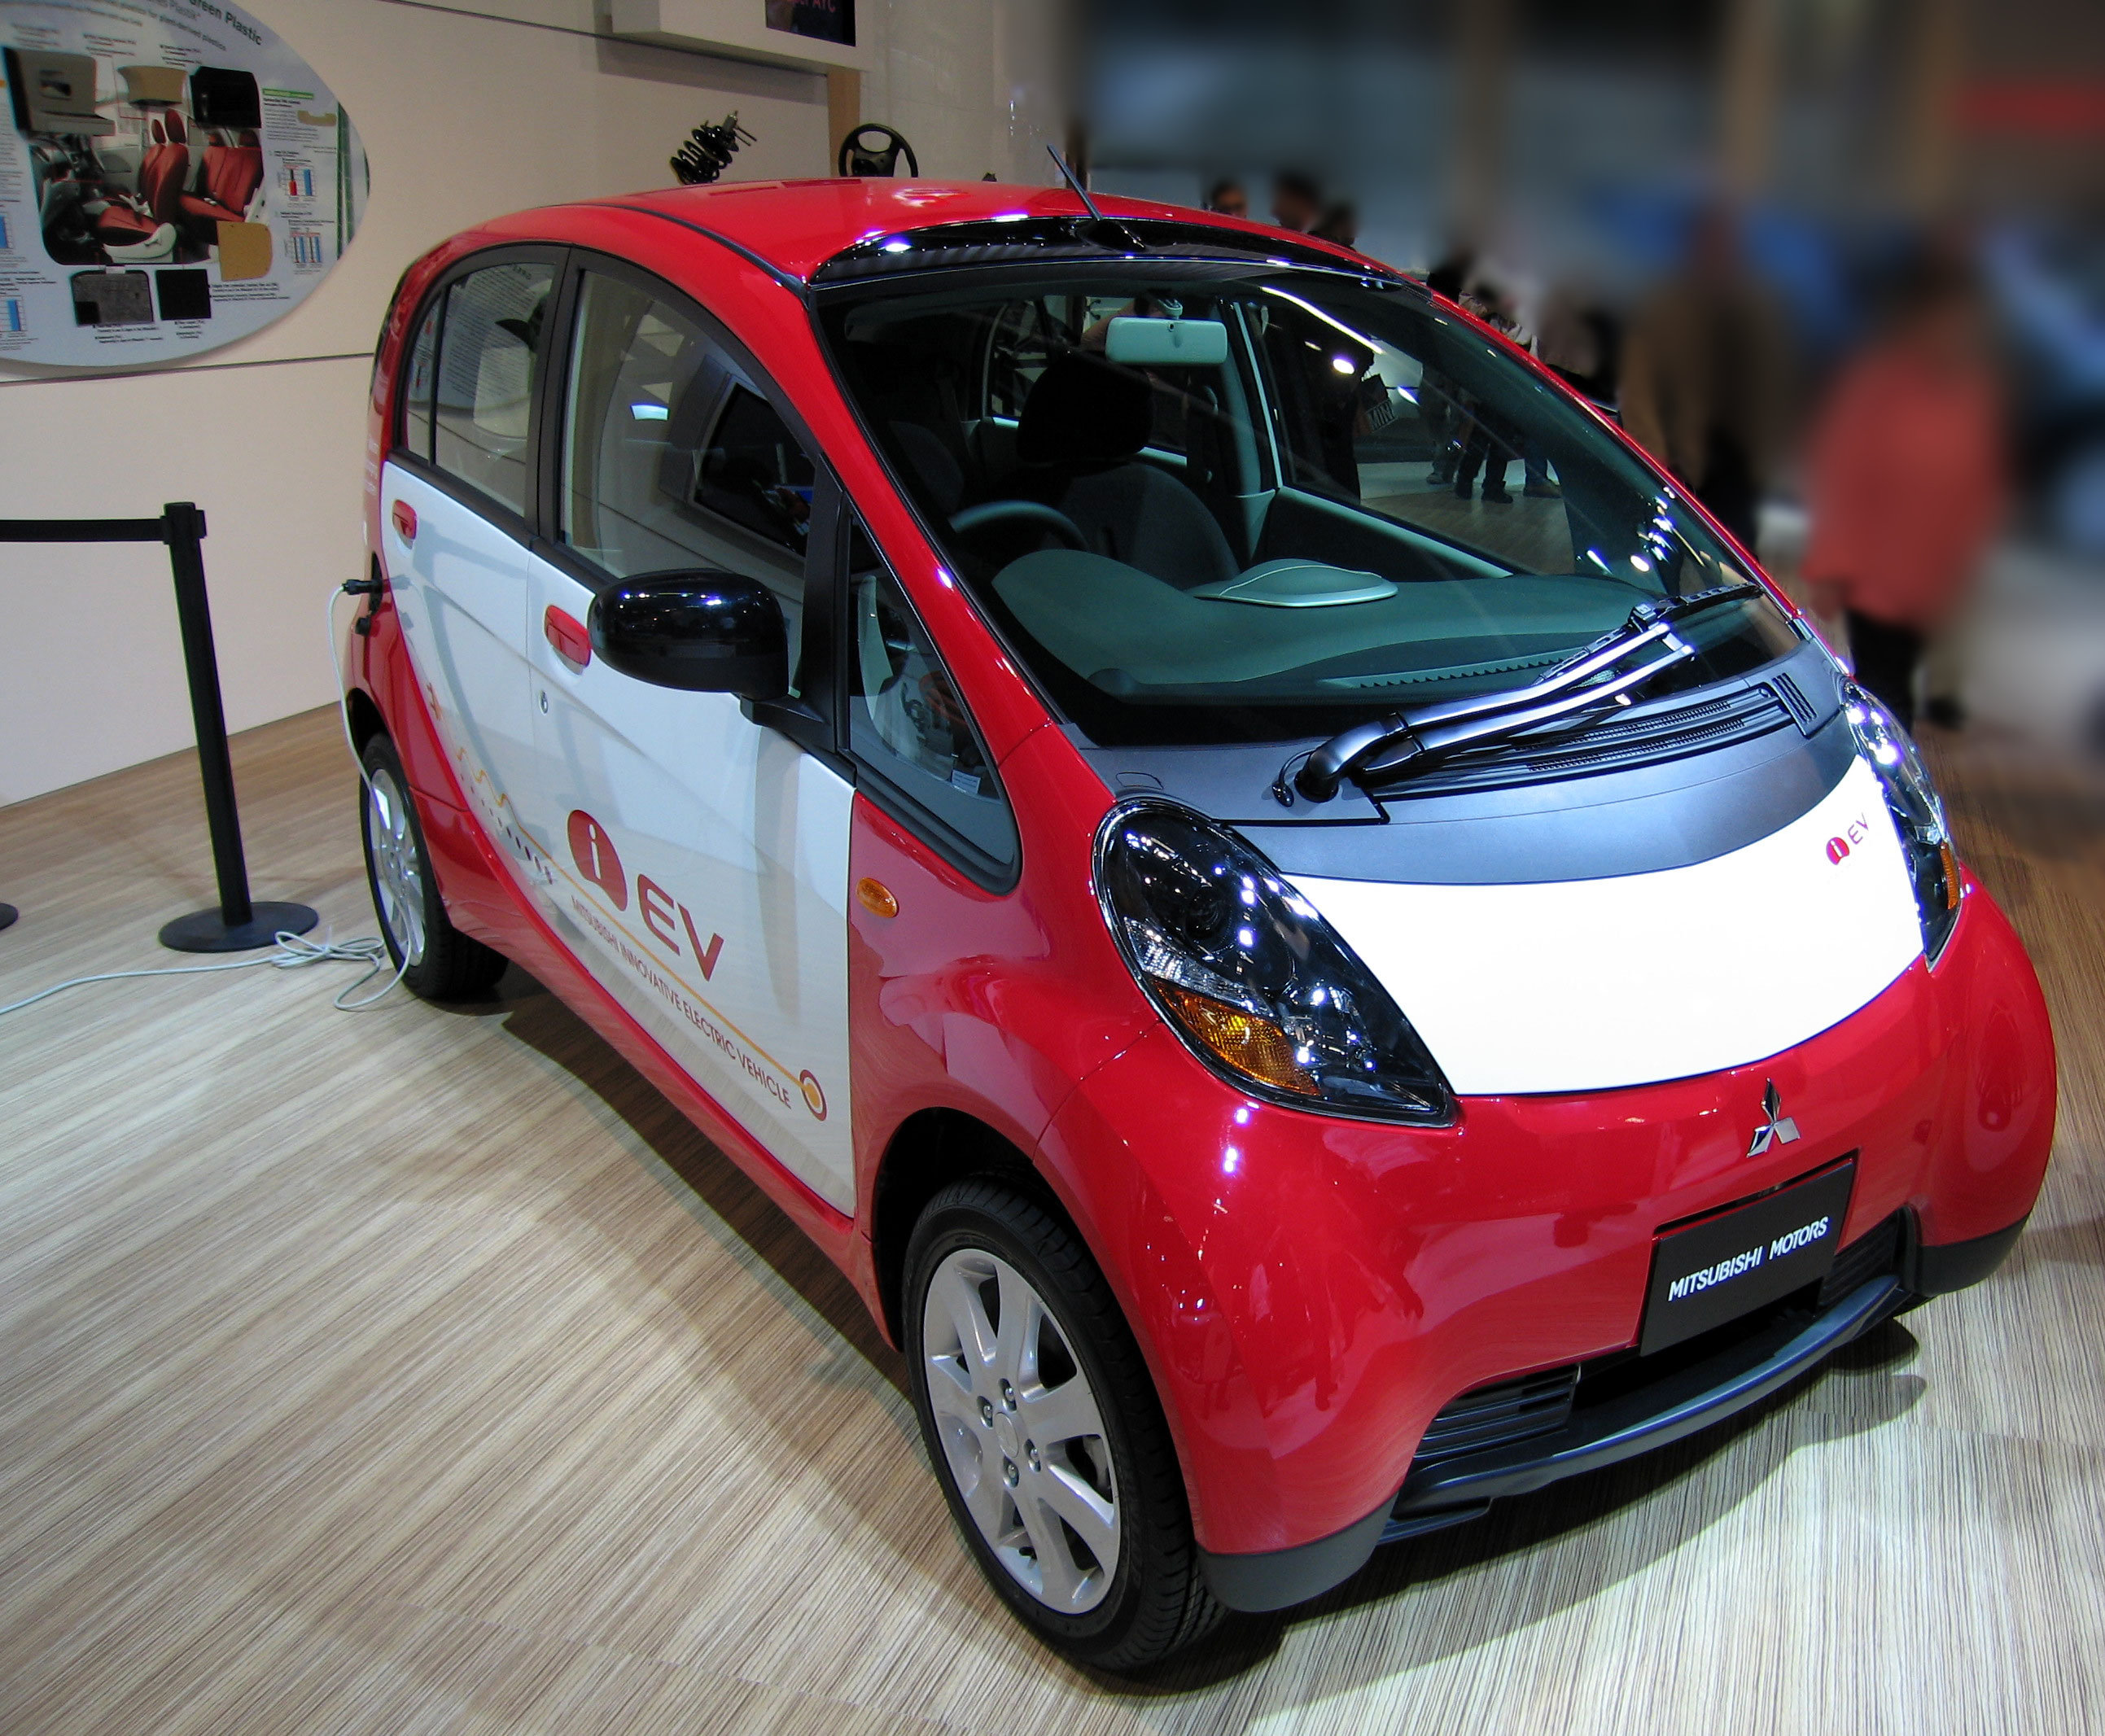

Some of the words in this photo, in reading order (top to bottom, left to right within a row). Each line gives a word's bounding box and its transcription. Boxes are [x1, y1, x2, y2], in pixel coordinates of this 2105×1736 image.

[225, 11, 262, 45] Plastic
[1848, 812, 1869, 845] EV
[637, 872, 724, 982] EV
[619, 941, 682, 1012] INNOVATIVE
[682, 999, 736, 1060] ELECTRIC
[736, 1047, 792, 1110] VEHICLE
[1668, 1245, 1763, 1302] MITSUBISHI
[1769, 1216, 1829, 1261] MOTORS
